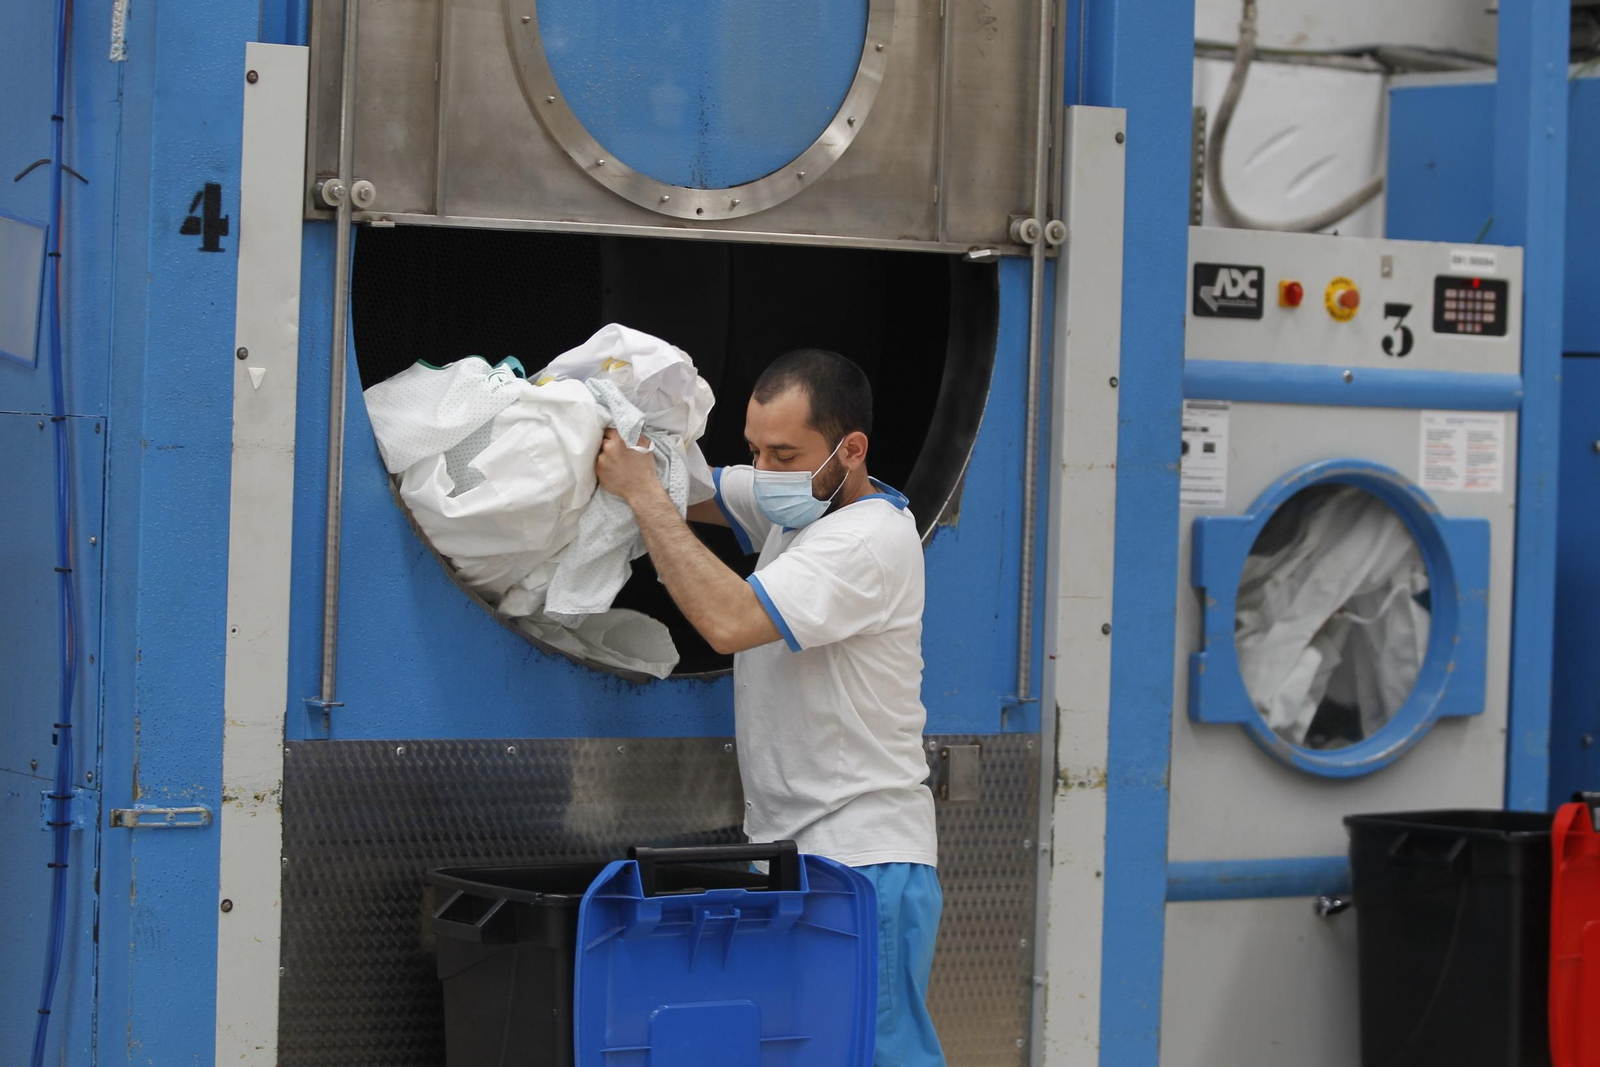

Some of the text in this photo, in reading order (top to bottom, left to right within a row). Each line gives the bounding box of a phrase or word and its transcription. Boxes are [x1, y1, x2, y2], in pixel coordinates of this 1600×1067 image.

[179, 183, 230, 252] 4
[1213, 267, 1259, 299] ADC
[1381, 302, 1414, 358] 3
